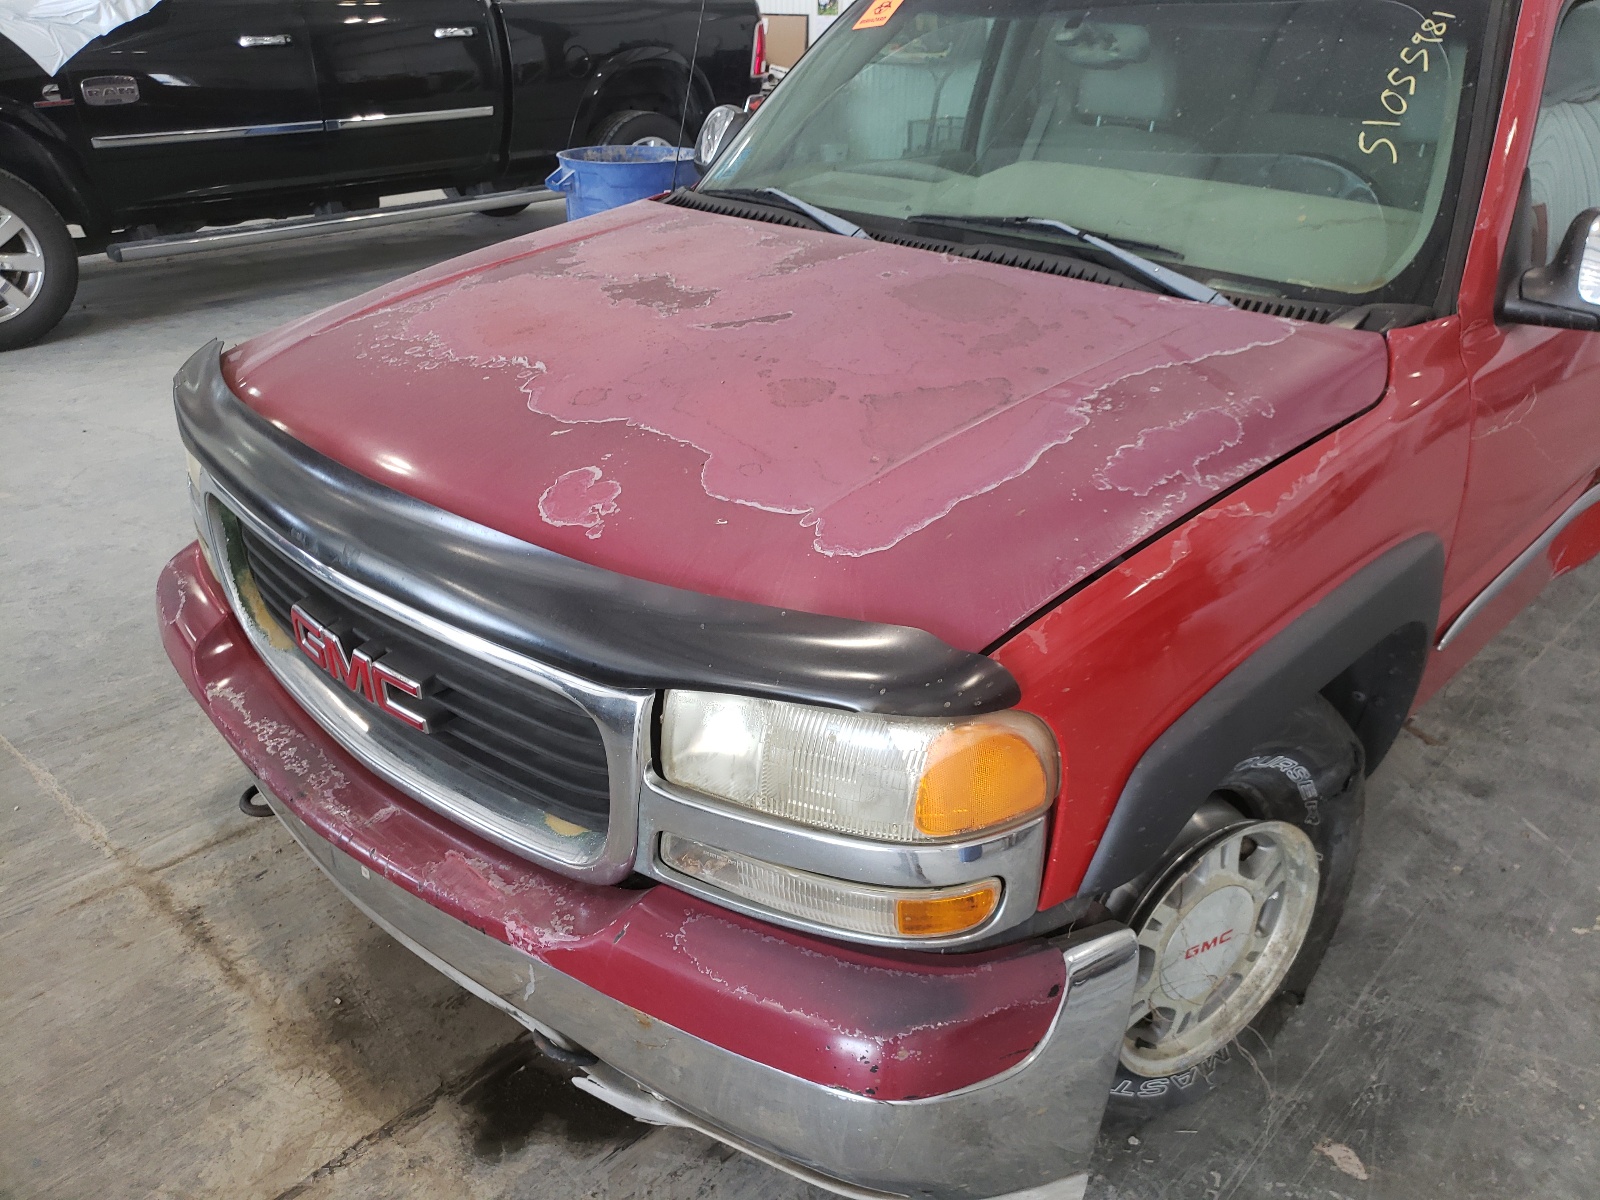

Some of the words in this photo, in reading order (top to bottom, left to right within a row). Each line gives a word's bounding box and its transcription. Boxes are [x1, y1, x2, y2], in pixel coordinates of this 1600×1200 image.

[1358, 11, 1456, 164] 51055981
[291, 604, 429, 734] GMC
[1184, 928, 1233, 960] GMC
